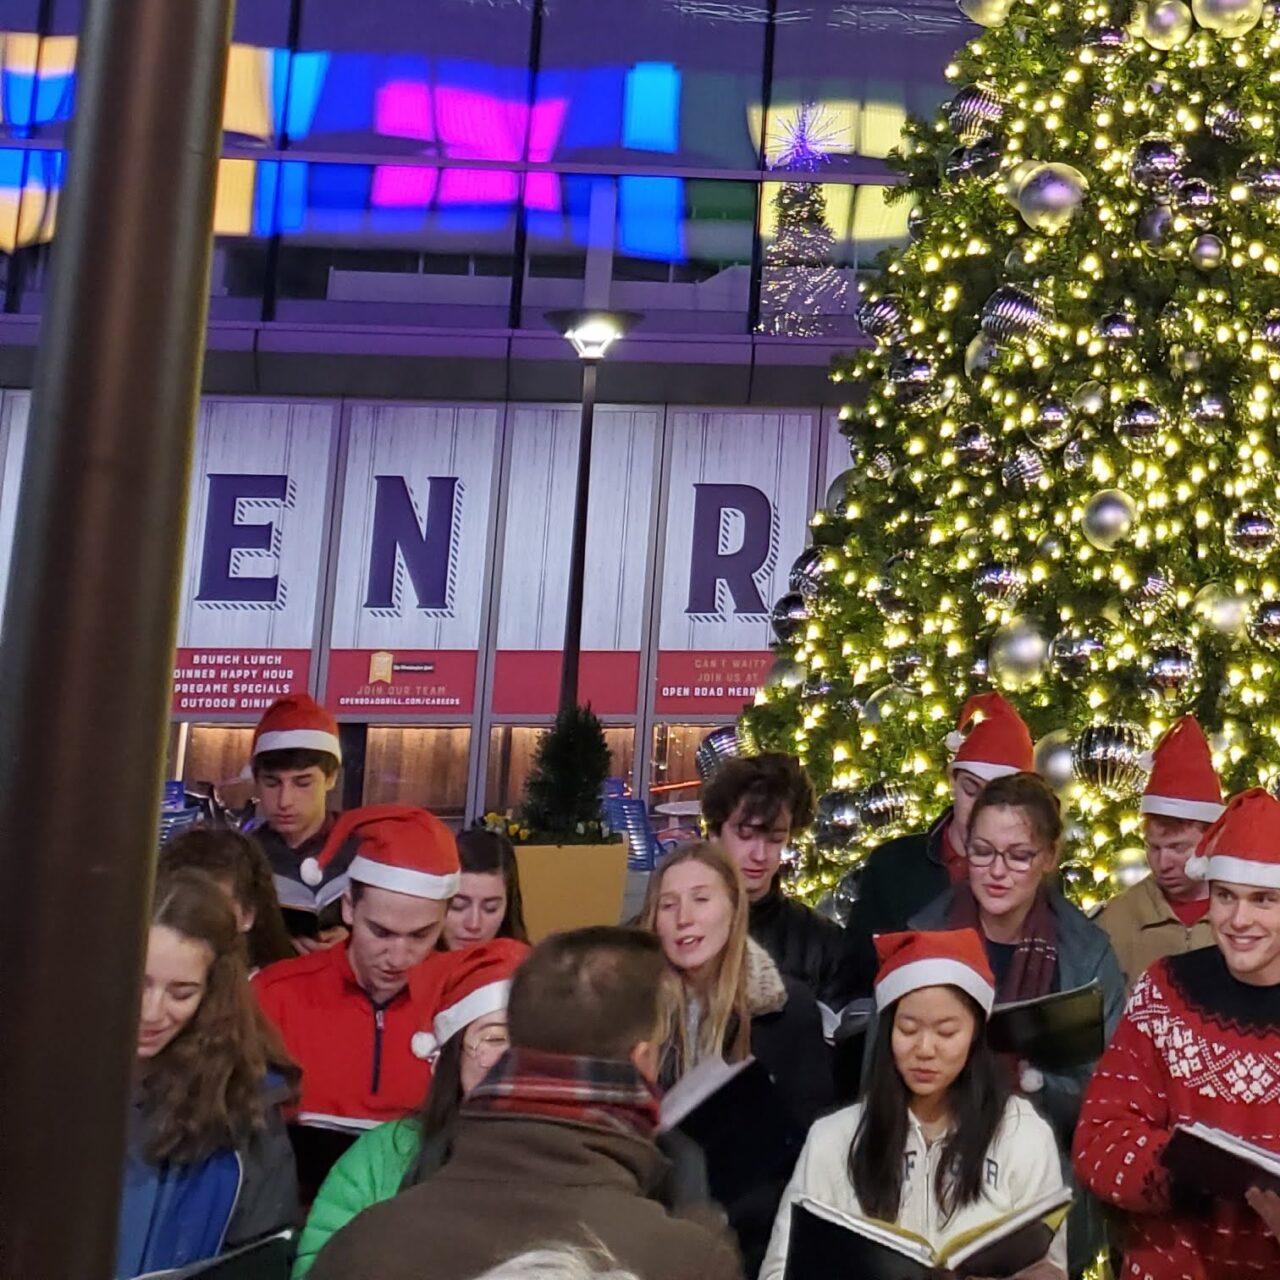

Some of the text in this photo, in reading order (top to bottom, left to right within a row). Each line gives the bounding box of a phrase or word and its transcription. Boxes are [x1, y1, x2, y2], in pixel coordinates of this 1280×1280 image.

[192, 655, 282, 665] BRUNCH LUNCH
[174, 669, 294, 679] DINNER HAPPY HOUR
[697, 673, 759, 682] JOIN US AT
[174, 684, 290, 694] PREGAME SPECIALS
[357, 686, 446, 695] JOIN OUR TEAM
[662, 687, 690, 696] OPEN
[694, 687, 724, 696] ROAD
[180, 698, 273, 708] OUTDOOR DININ
